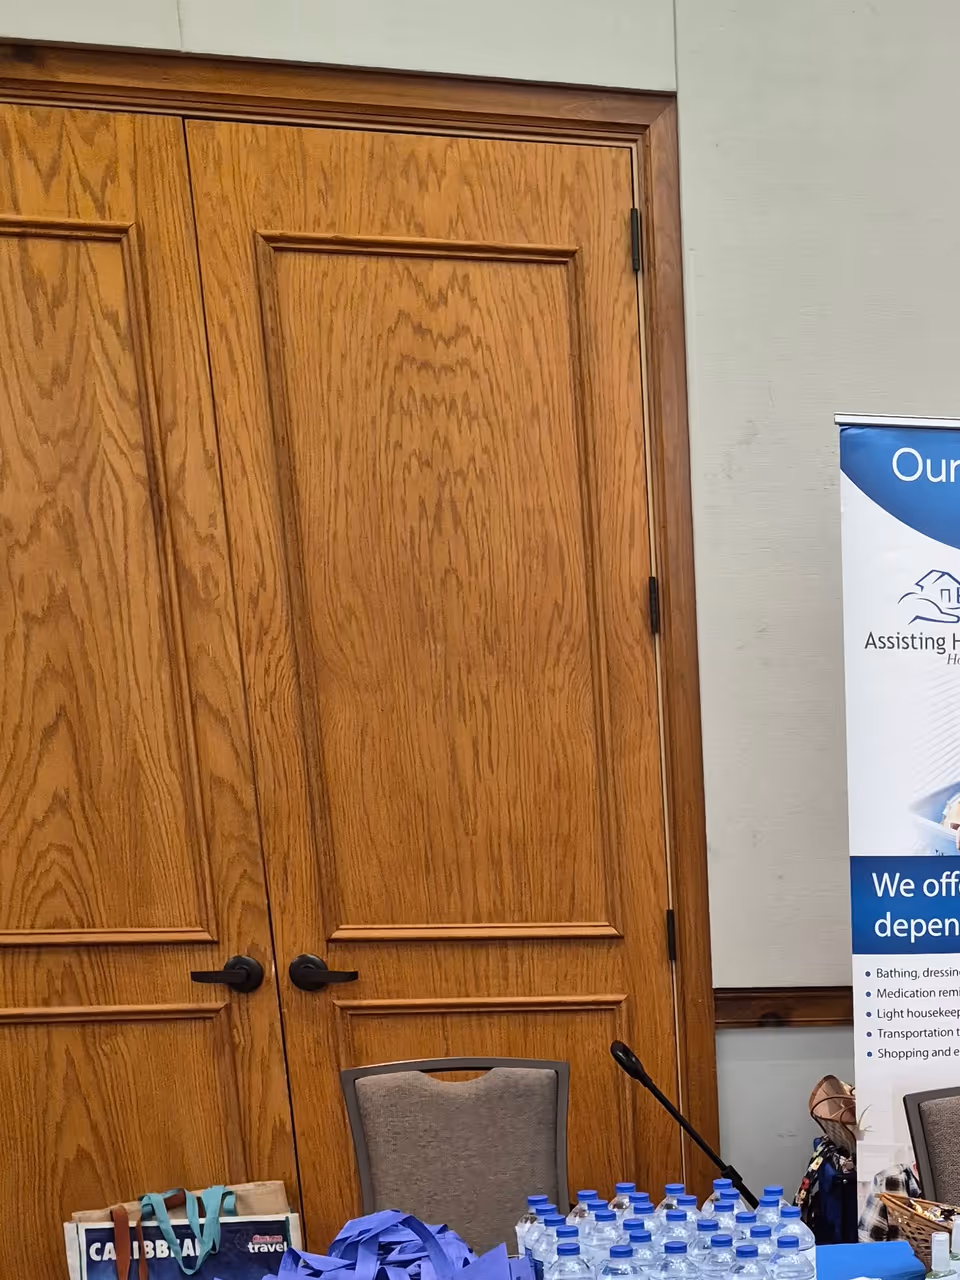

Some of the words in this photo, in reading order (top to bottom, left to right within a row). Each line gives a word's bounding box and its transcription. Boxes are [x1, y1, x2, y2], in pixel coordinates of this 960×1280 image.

[864, 631, 946, 655] Assisting
[872, 872, 915, 898] We
[876, 967, 920, 980] Bathing,
[876, 987, 936, 999] Medication
[877, 1008, 904, 1021] Light
[877, 1028, 954, 1042] Transportation
[877, 1048, 929, 1061] Shopping
[931, 1047, 951, 1058] and
[89, 1238, 201, 1261] CAIBBA
[248, 1241, 287, 1253] travel
